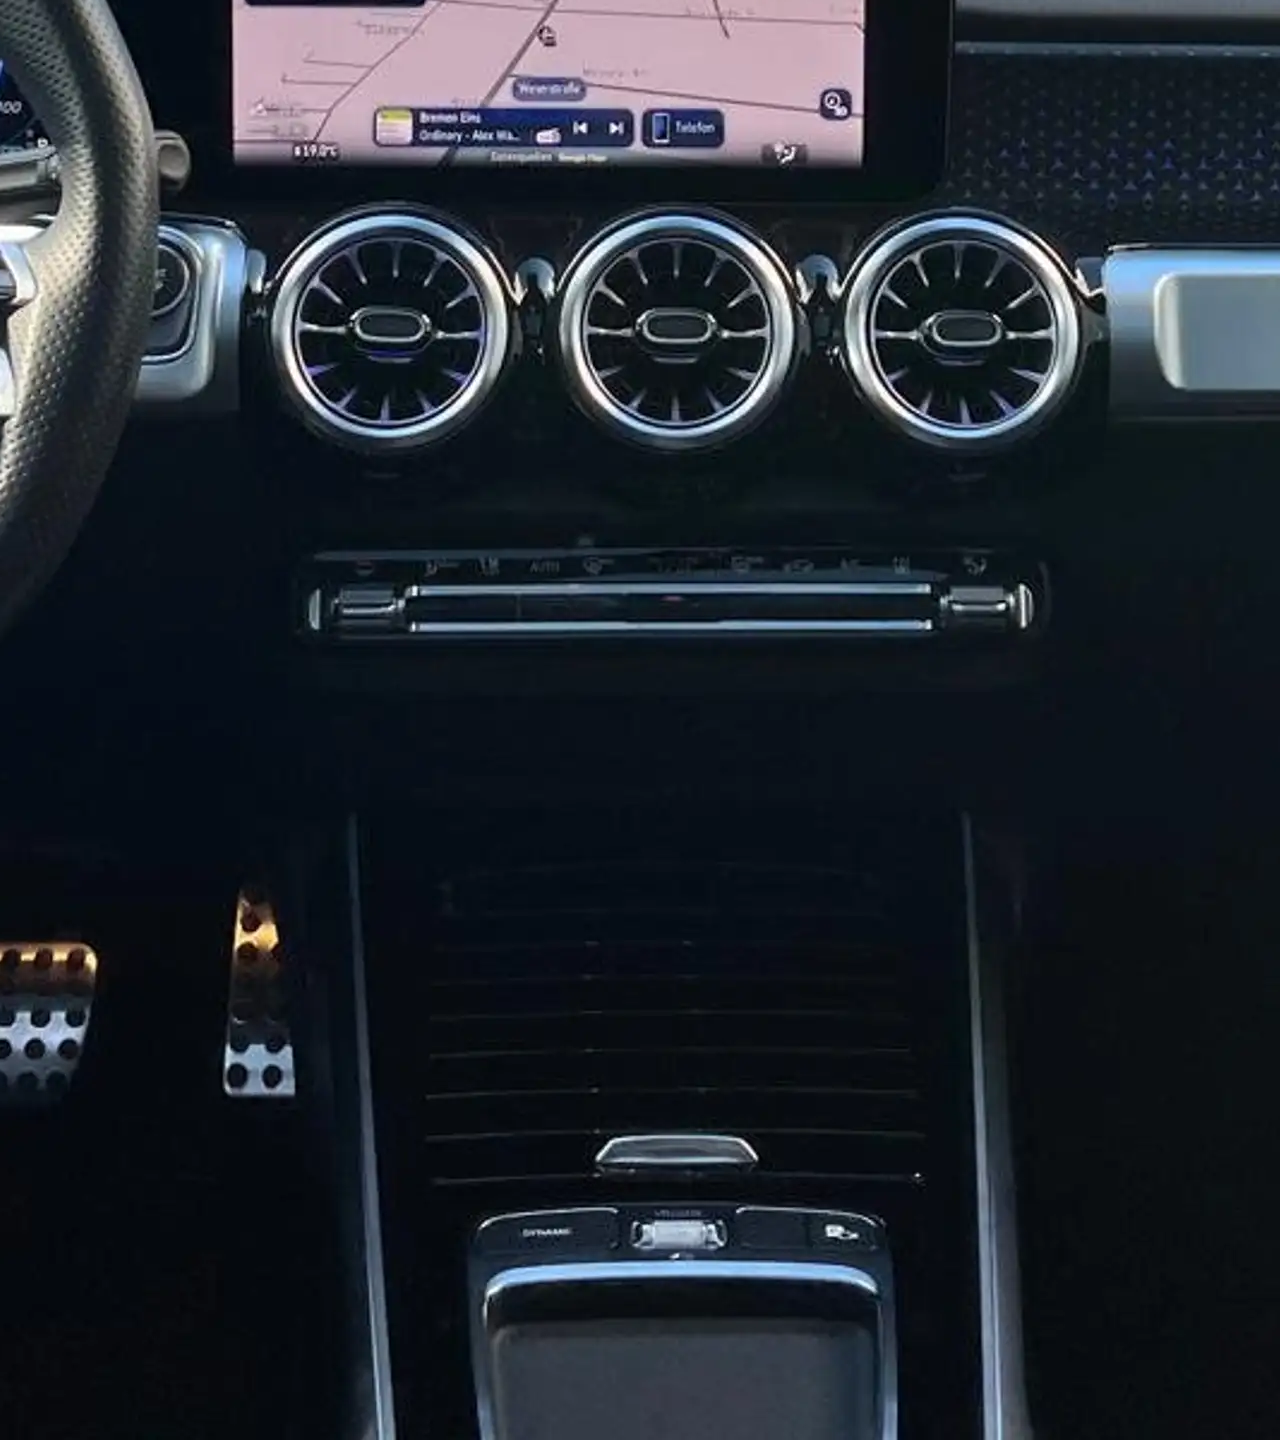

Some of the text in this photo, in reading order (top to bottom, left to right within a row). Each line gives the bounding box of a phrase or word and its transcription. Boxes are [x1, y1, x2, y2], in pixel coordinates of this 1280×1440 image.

[419, 112, 458, 124] Bremen
[675, 122, 716, 135] Telefon
[419, 129, 462, 142] Ordinary
[472, 129, 493, 141] Alex
